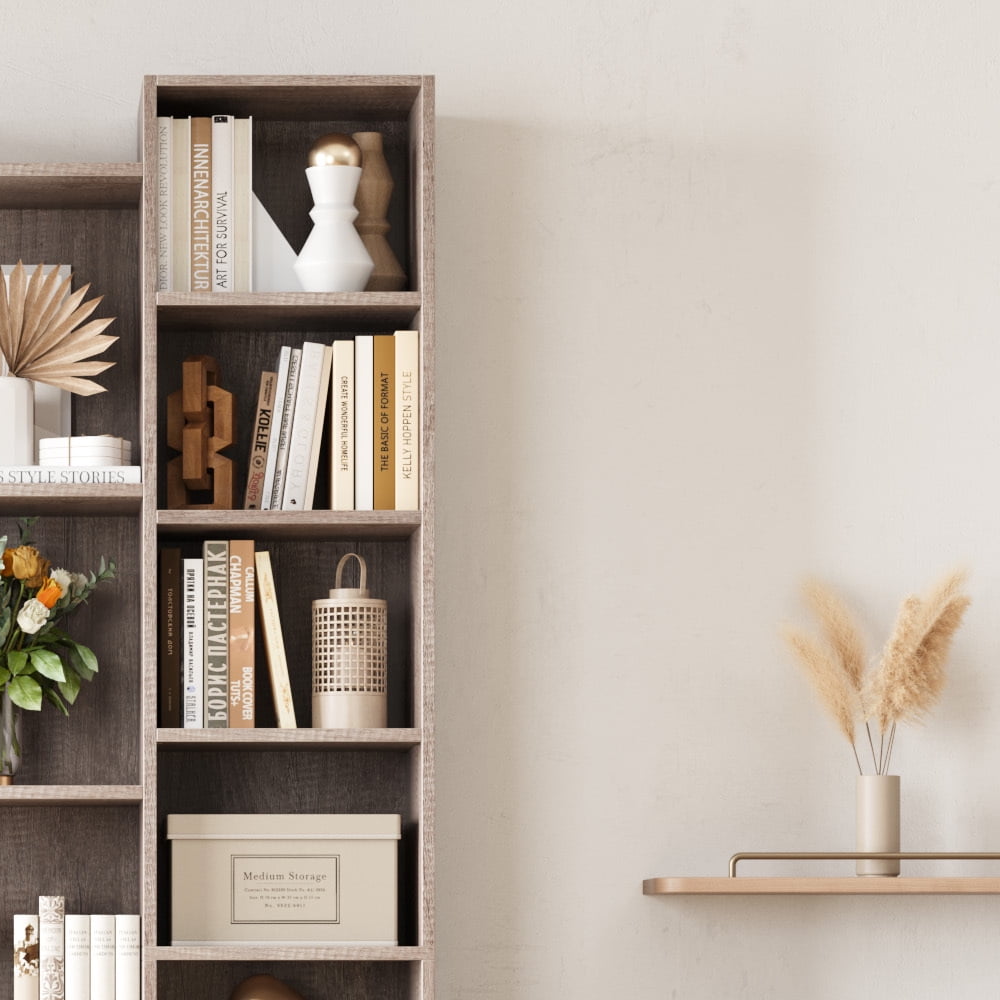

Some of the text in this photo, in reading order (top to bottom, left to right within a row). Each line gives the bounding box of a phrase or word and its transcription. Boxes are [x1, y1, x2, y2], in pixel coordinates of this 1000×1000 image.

[160, 126, 168, 197] REVOLUTION
[160, 199, 168, 230] LOOK
[193, 143, 210, 290] INNENARCHITEKTUR
[216, 191, 228, 288] ART FOR SURVIVAL
[160, 234, 168, 258] NEW
[340, 376, 348, 472] CREATE WONDERFUL HOMELIFE
[380, 372, 389, 472] THE BASIC OF FORMAT
[402, 371, 412, 478] KELLY HOPPEN STYLE
[8, 471, 56, 484] STYLE
[60, 471, 125, 484] STORIES
[229, 555, 242, 614] CHAPMAN
[245, 566, 255, 602] CALLUM
[207, 550, 227, 721] БОРИС ПАСТЕРНАК
[231, 680, 241, 707] TUTS+
[242, 667, 253, 721] BOOK COVER
[243, 872, 328, 884] Medium Storage
